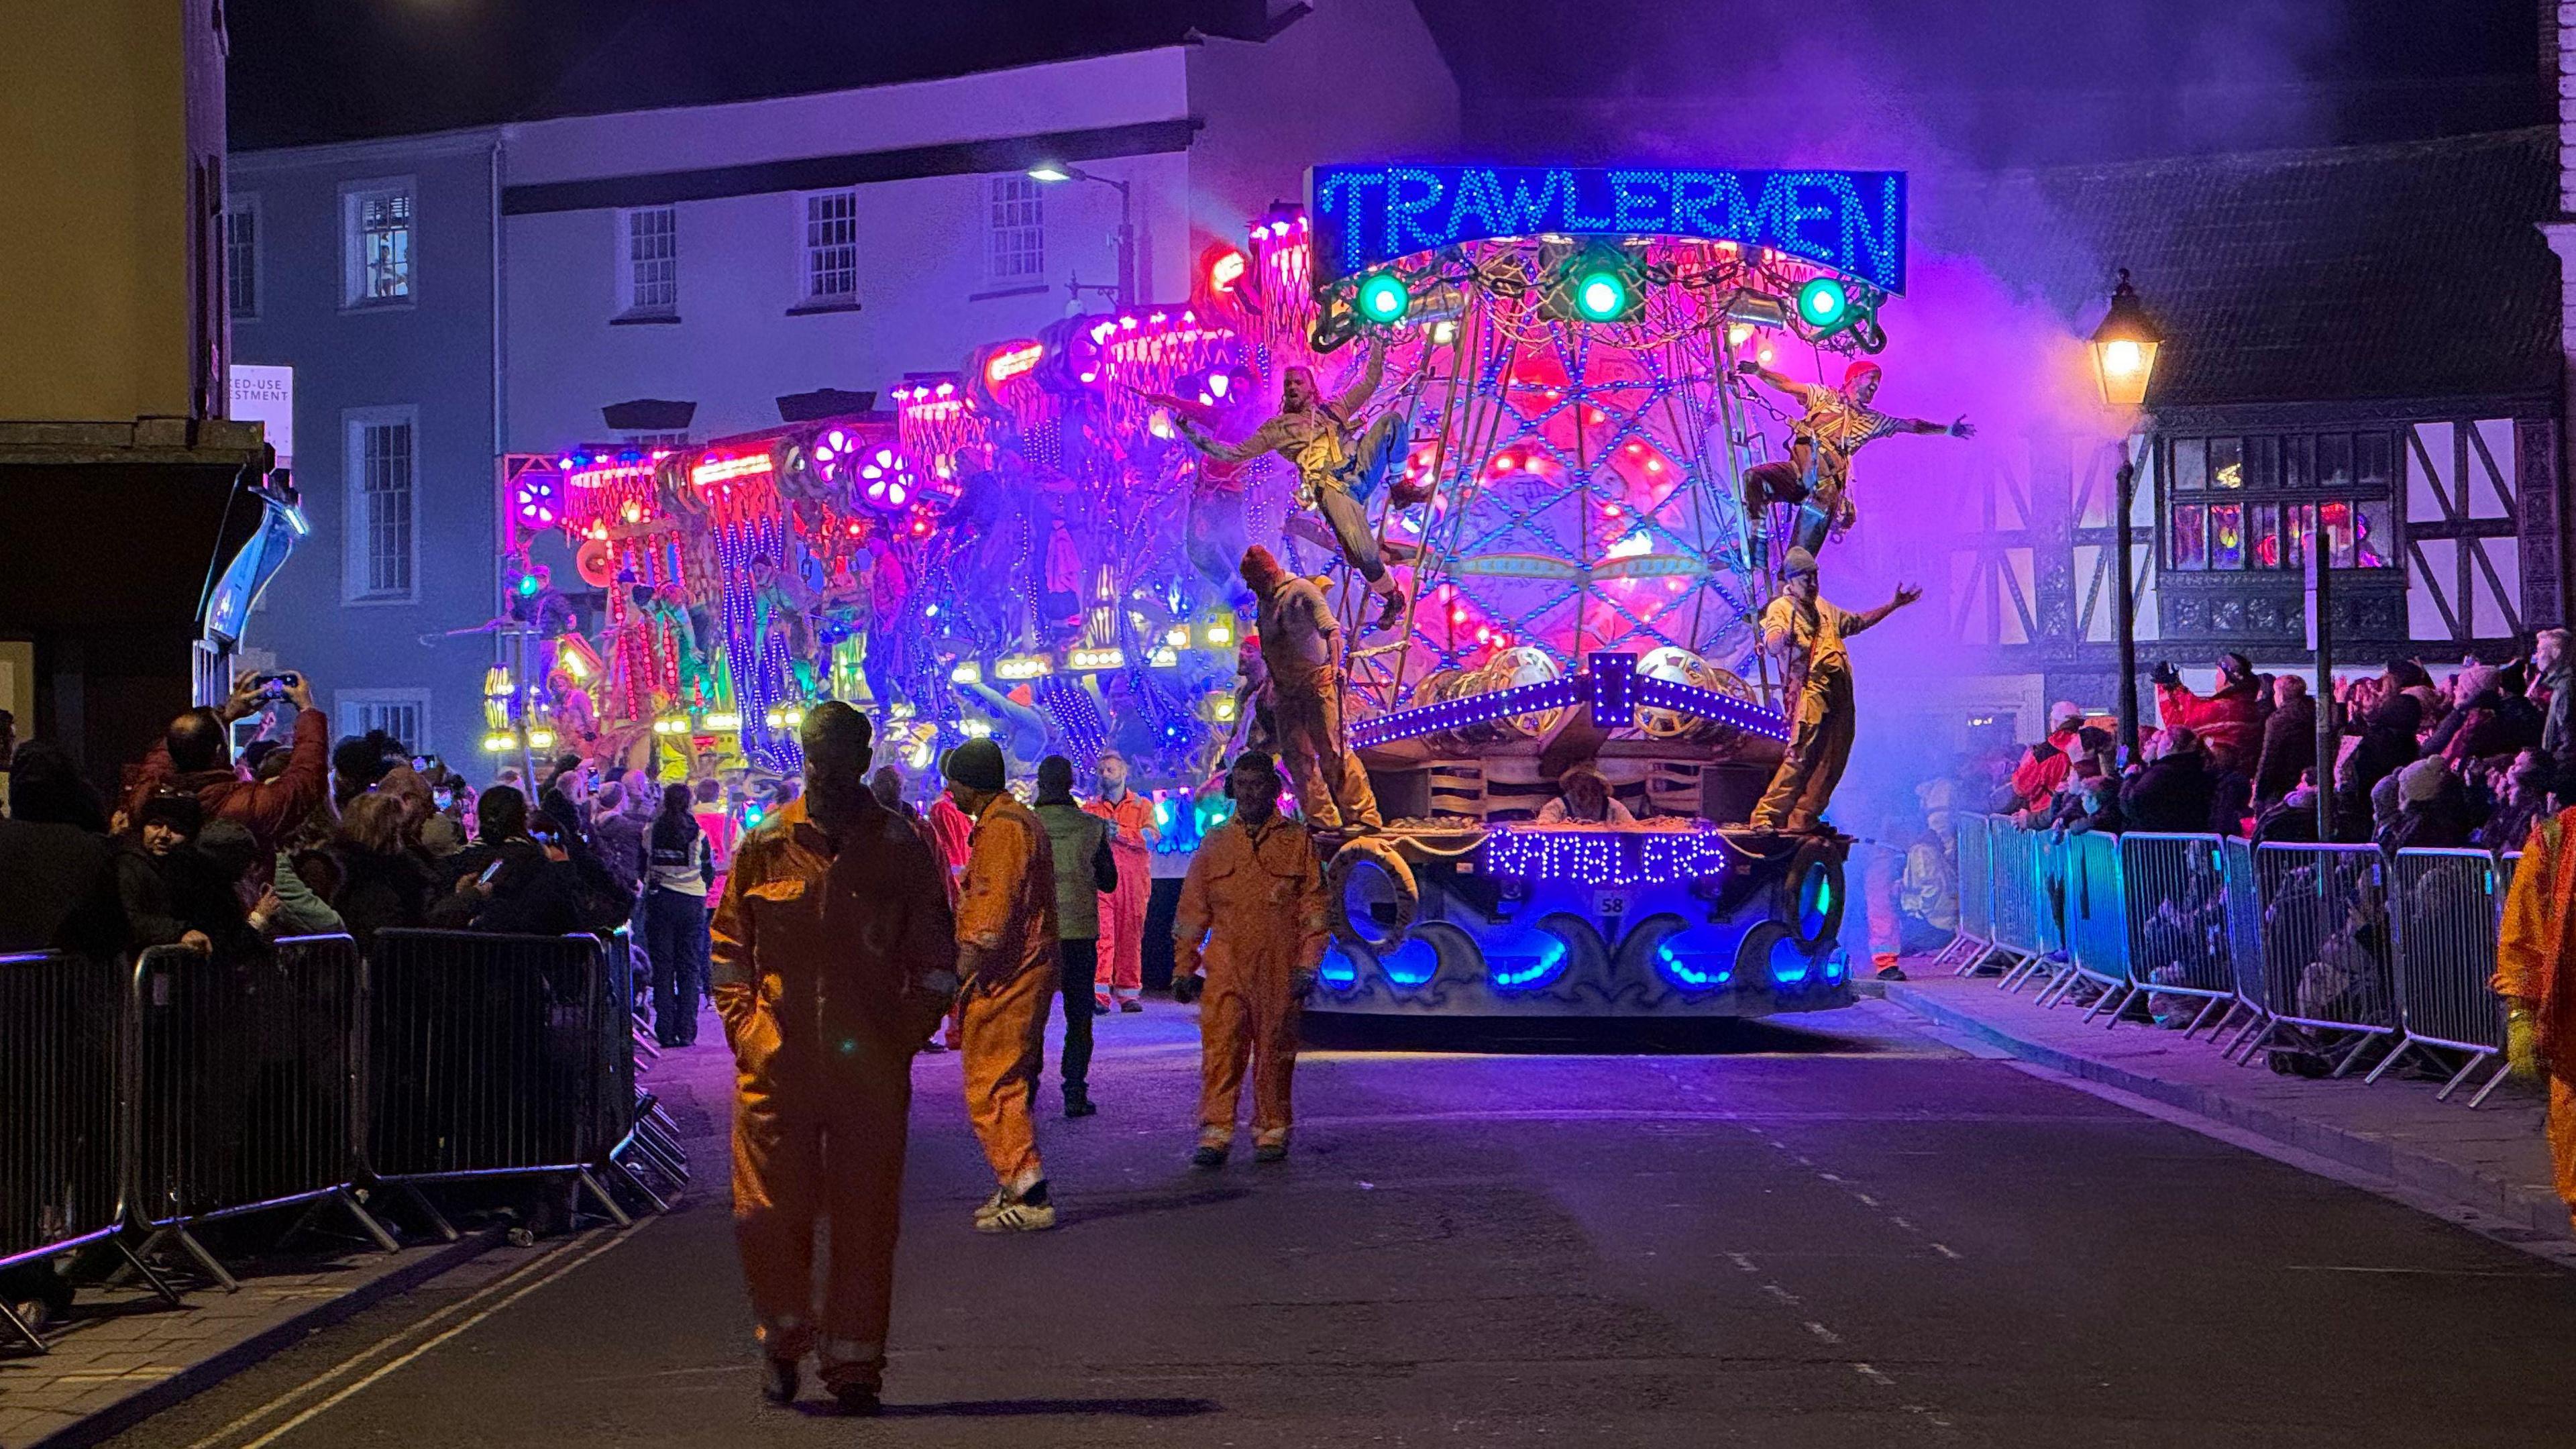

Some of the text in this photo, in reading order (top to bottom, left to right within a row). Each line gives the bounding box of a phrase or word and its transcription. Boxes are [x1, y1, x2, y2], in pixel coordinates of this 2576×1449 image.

[1320, 168, 1896, 287] TRAWLERMEN
[1487, 828, 1725, 885] RAMBLERS
[1602, 898, 1623, 913] 58
